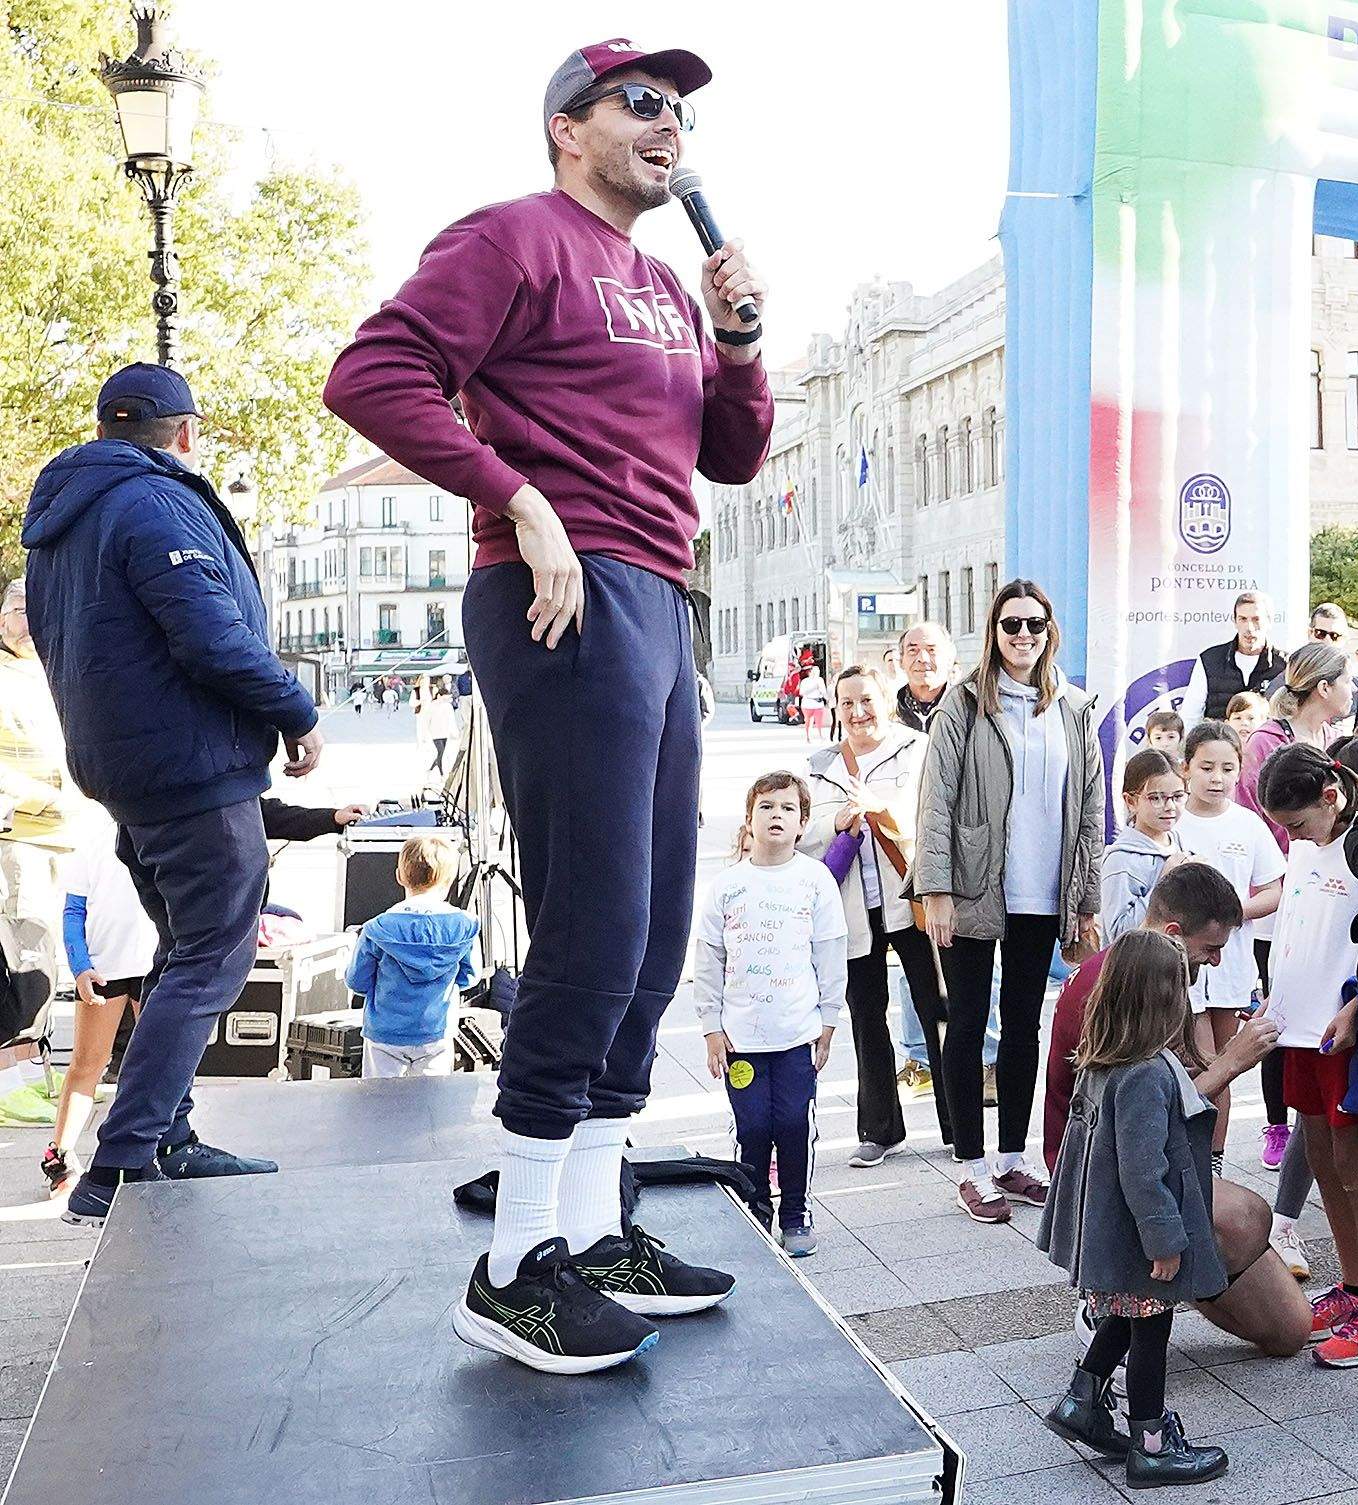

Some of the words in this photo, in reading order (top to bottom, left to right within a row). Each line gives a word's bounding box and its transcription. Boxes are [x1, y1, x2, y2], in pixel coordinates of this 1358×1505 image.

[1228, 564, 1244, 573] DE
[1150, 576, 1259, 592] PONTEVEDRA
[736, 932, 775, 944] SANCHO
[746, 965, 773, 976] AGUS
